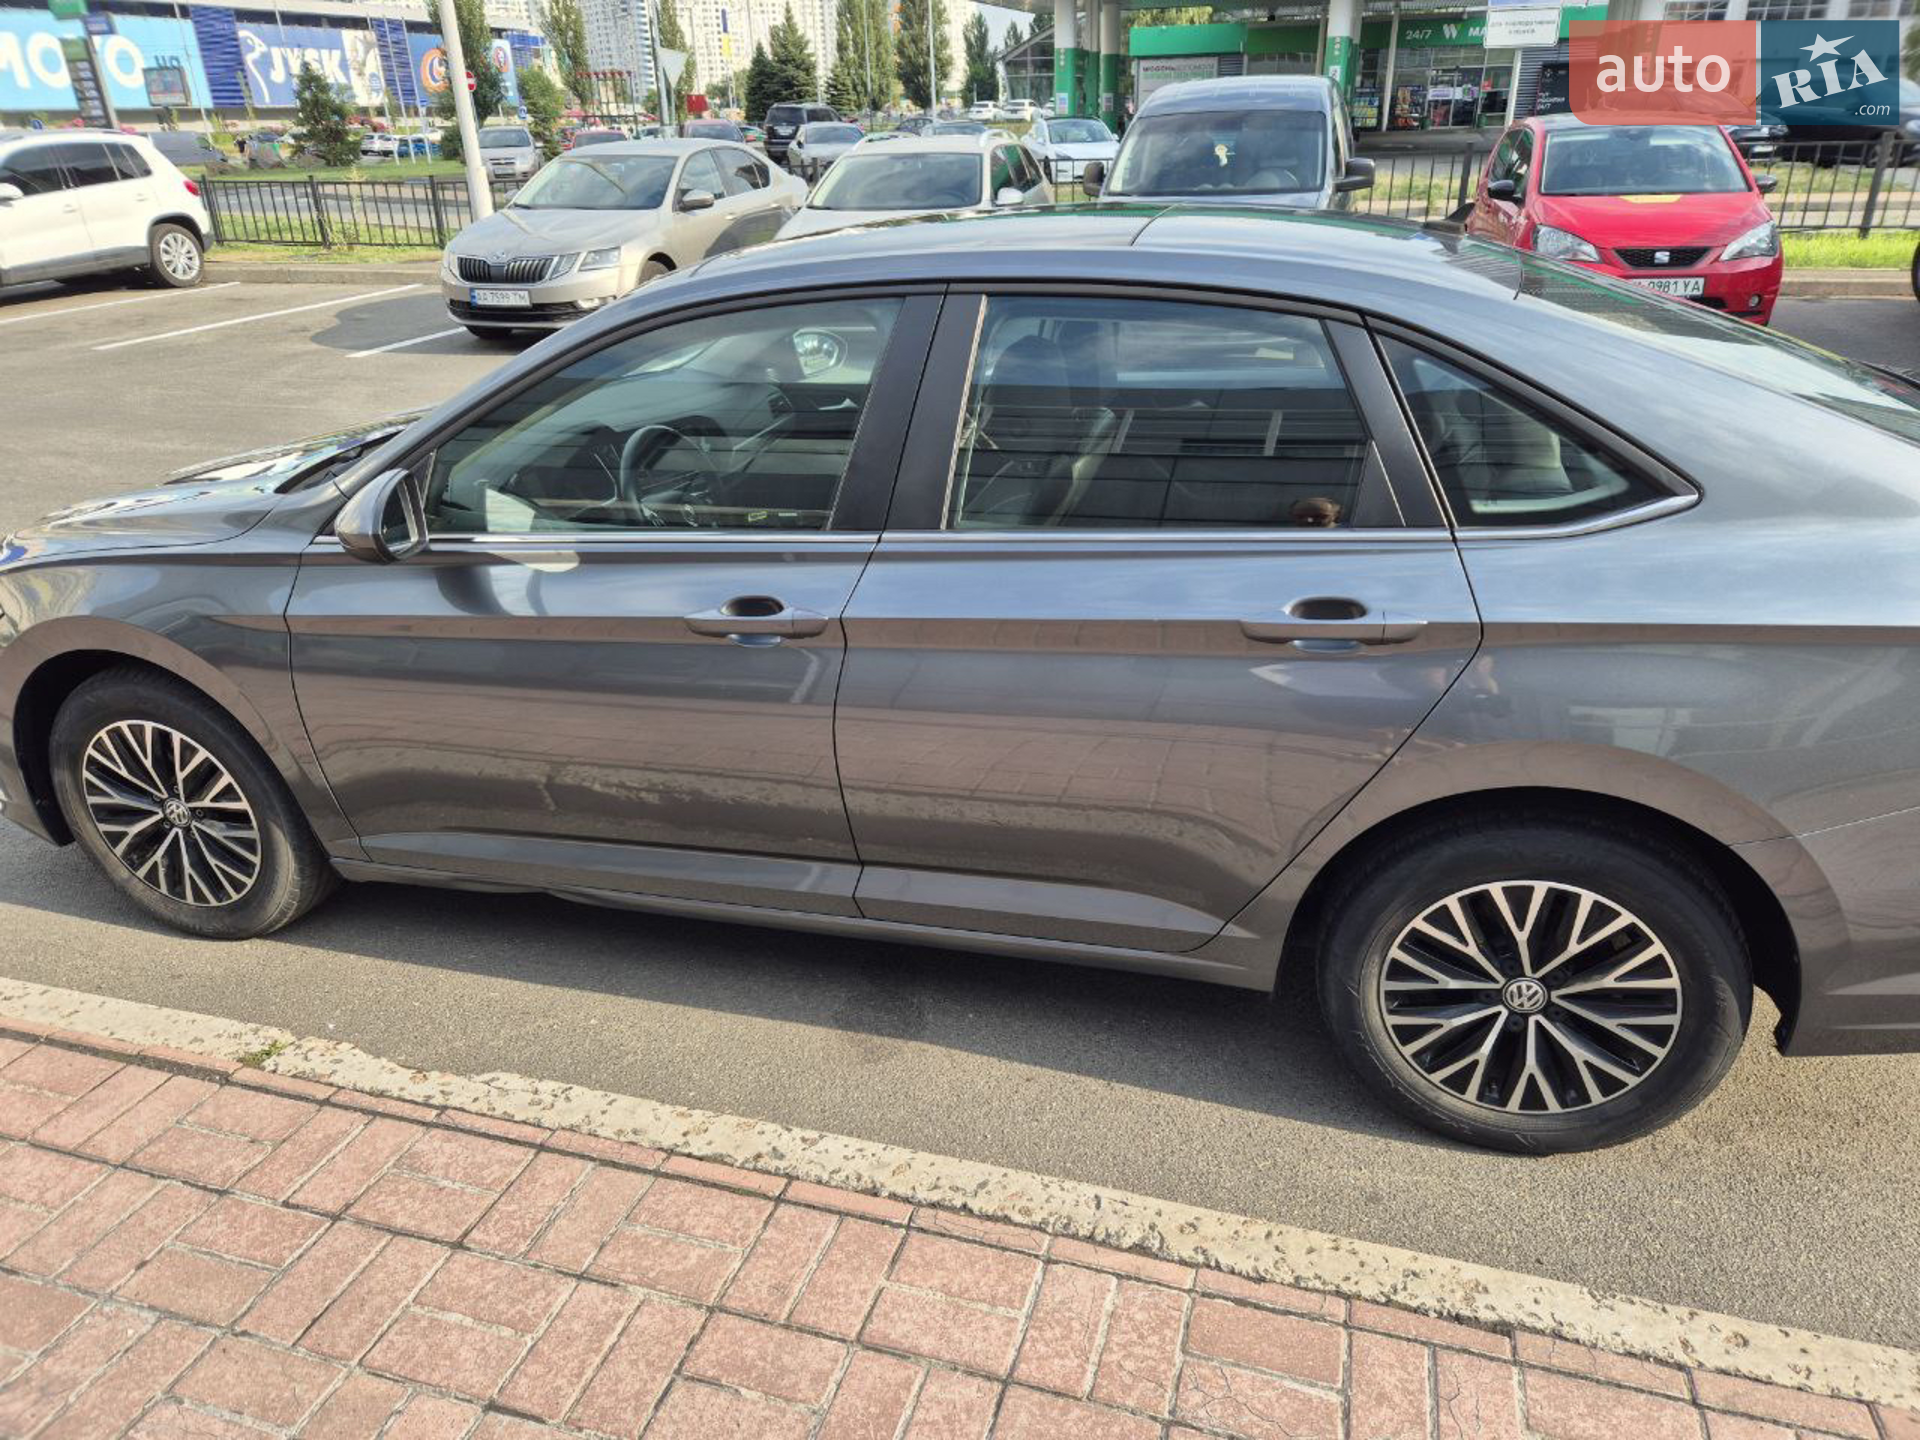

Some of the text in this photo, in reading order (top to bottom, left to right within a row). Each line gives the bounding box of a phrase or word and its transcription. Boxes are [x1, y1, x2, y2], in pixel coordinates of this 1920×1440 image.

[1405, 29, 1431, 40] 24/7
[270, 47, 348, 84] JYSK
[1683, 280, 1700, 292] YA
